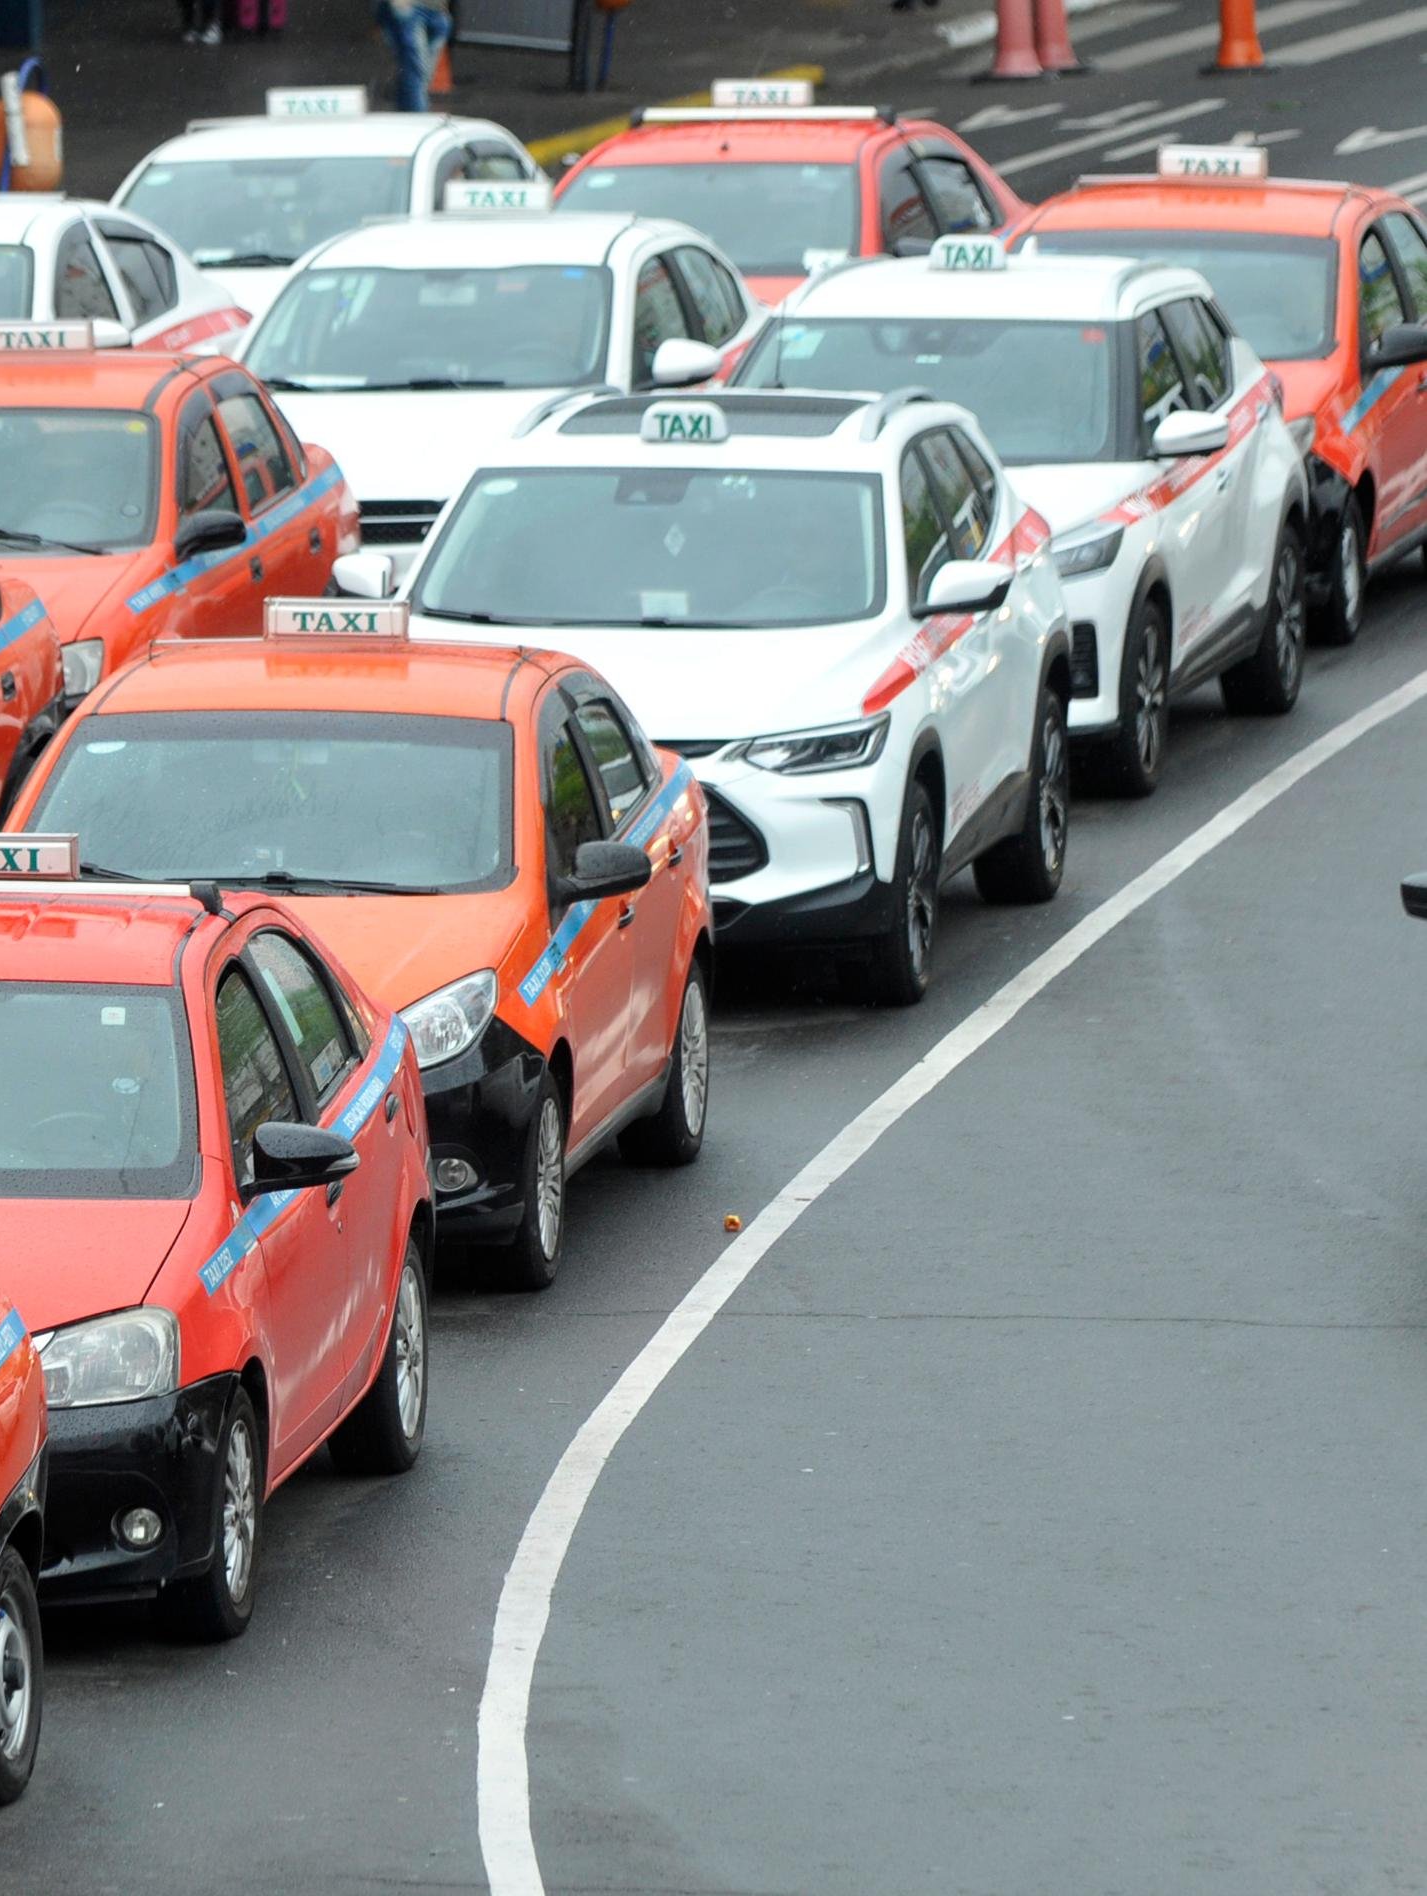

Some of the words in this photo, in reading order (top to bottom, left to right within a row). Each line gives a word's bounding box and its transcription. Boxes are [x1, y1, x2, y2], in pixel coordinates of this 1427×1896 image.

[733, 89, 789, 105] TAXI
[285, 99, 339, 115] TAXI
[1179, 158, 1241, 176] TAXI
[467, 191, 527, 207] TAXI
[942, 244, 995, 266] TAXI
[0, 332, 65, 349] TAXI
[655, 414, 711, 439] TAXI
[293, 612, 377, 632] TAXI
